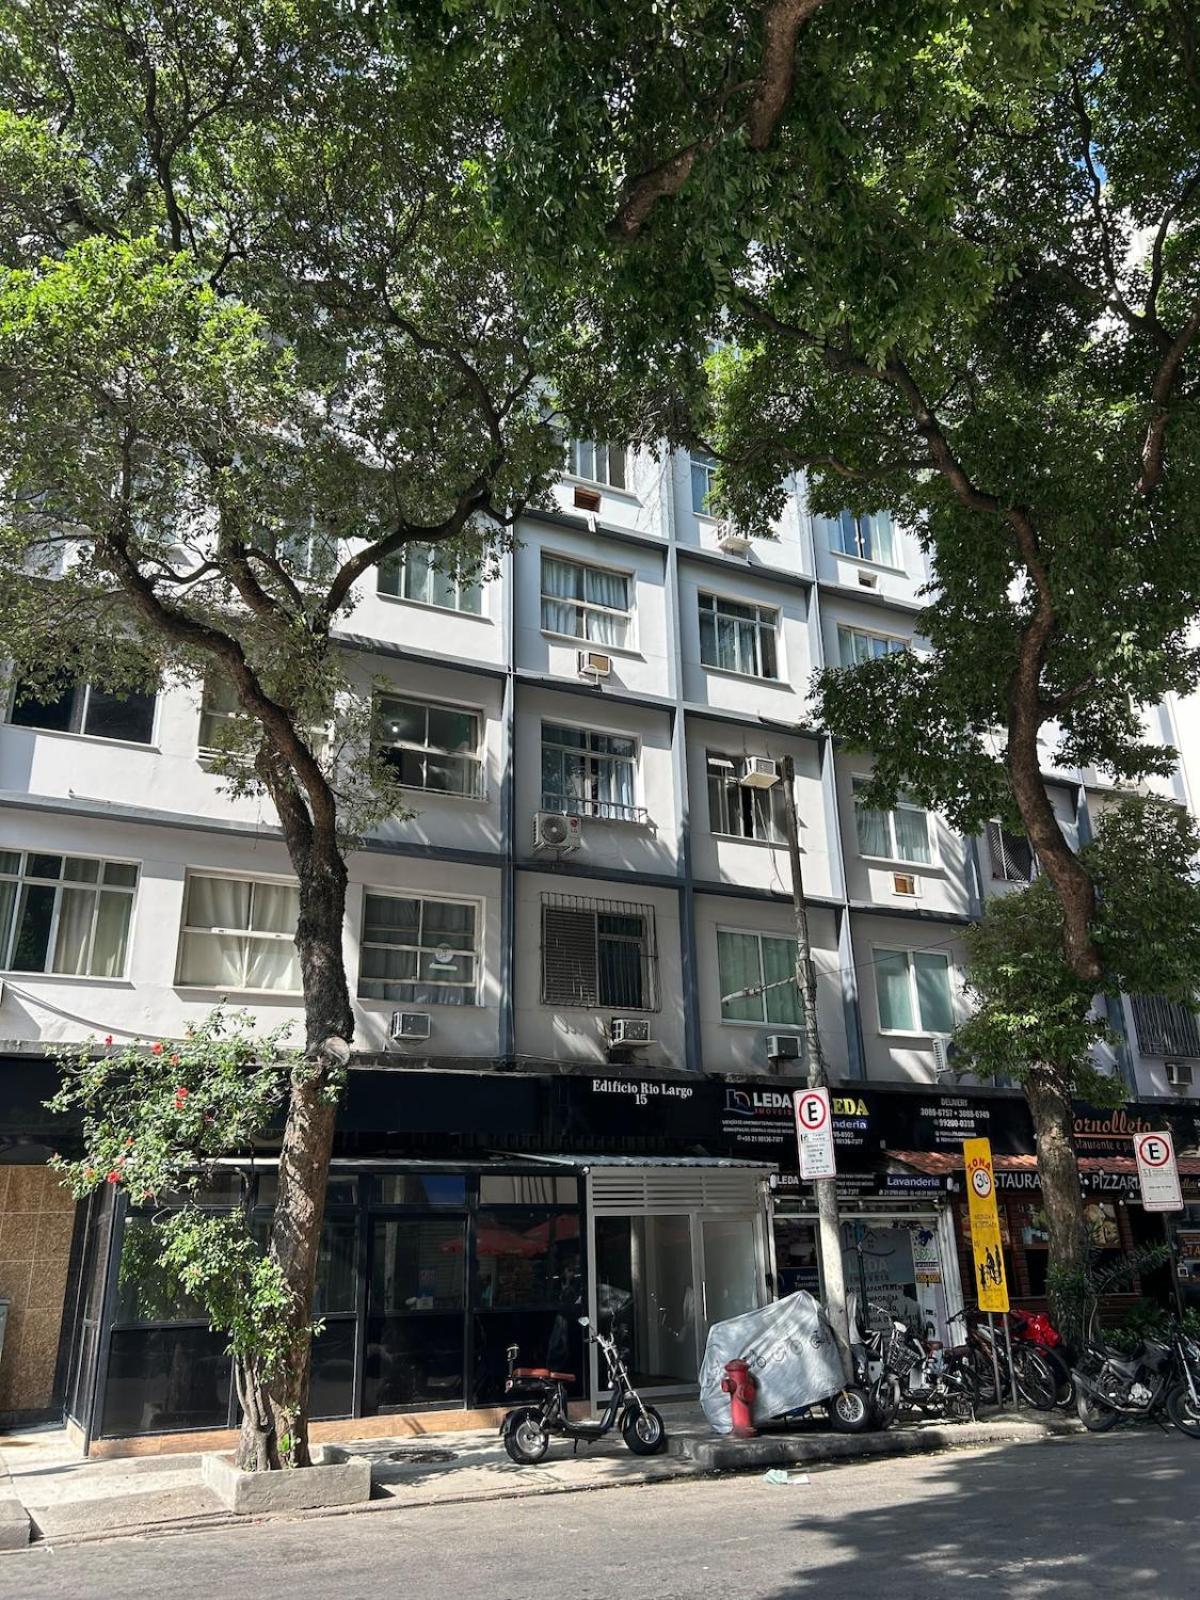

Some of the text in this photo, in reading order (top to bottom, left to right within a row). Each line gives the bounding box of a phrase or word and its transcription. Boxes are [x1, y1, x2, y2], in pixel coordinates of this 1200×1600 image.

[635, 1093, 648, 1104] 15
[640, 1082, 660, 1094] Rio
[661, 1083, 693, 1099] Largo
[753, 1092, 792, 1108] LEDA
[831, 1098, 870, 1116] EDA
[807, 1101, 818, 1121] E
[833, 1119, 867, 1129] nderia
[1073, 1110, 1152, 1133] ornolleto
[1148, 1143, 1160, 1160] E
[967, 1158, 991, 1173] ZONA
[777, 1174, 799, 1185] LEDA
[887, 1176, 940, 1187] Lavanderia
[975, 1173, 989, 1188] 30
[994, 1173, 1139, 1190] STAURA PIZZARI
